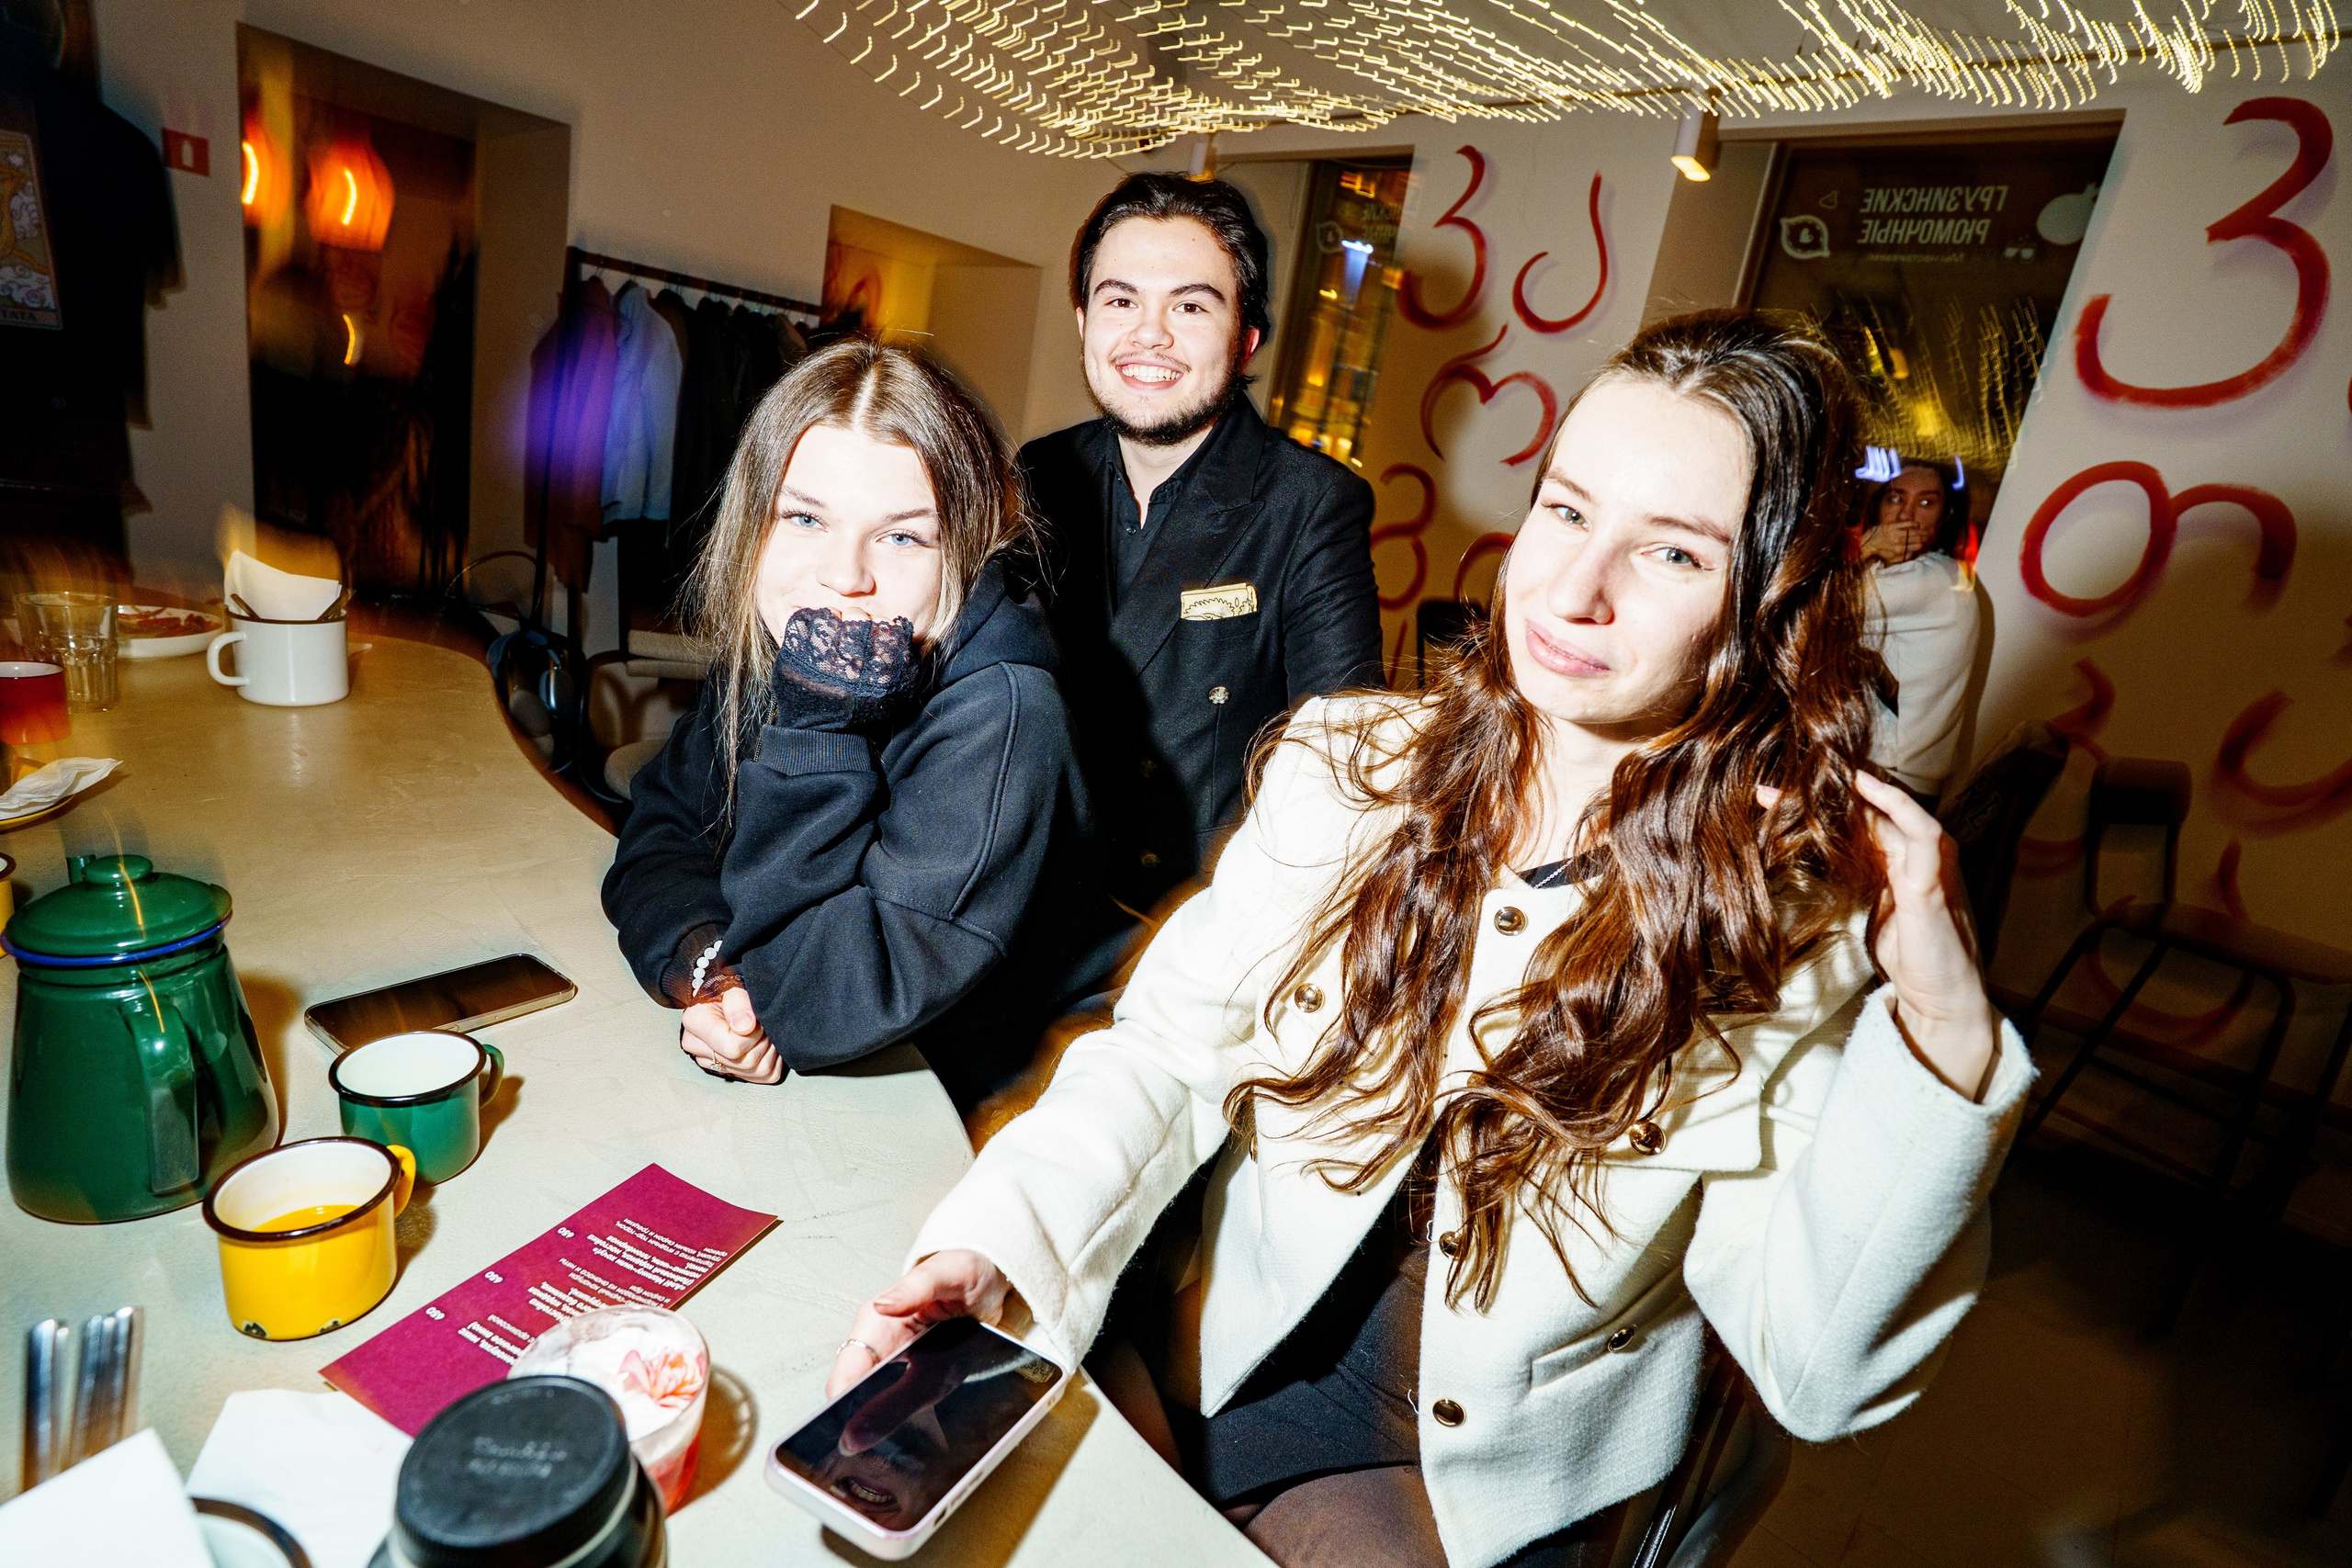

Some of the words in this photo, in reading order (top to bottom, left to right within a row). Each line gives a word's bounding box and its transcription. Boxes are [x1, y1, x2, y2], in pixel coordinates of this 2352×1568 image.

[557, 1226, 575, 1239] 650
[624, 1218, 650, 1234] грецким
[587, 1235, 622, 1254] настойка
[606, 1235, 651, 1259] пломбирная
[653, 1235, 674, 1246] сыром
[593, 1247, 617, 1261] хочу!»
[622, 1250, 654, 1269] кордиал,
[679, 1253, 714, 1268] Тарталетка
[696, 1251, 721, 1261] грушей,
[559, 1258, 577, 1269] мяты
[651, 1257, 702, 1279] малина-чили,
[684, 1262, 708, 1275] пена).
[484, 1270, 503, 1284] 650
[569, 1272, 600, 1291] хачапури
[580, 1269, 609, 1286] ананаса
[541, 1281, 578, 1305] базилика,
[628, 1284, 644, 1294] бри
[642, 1291, 668, 1301] сыром
[528, 1287, 562, 1307] кордиал
[425, 1306, 446, 1320] 650
